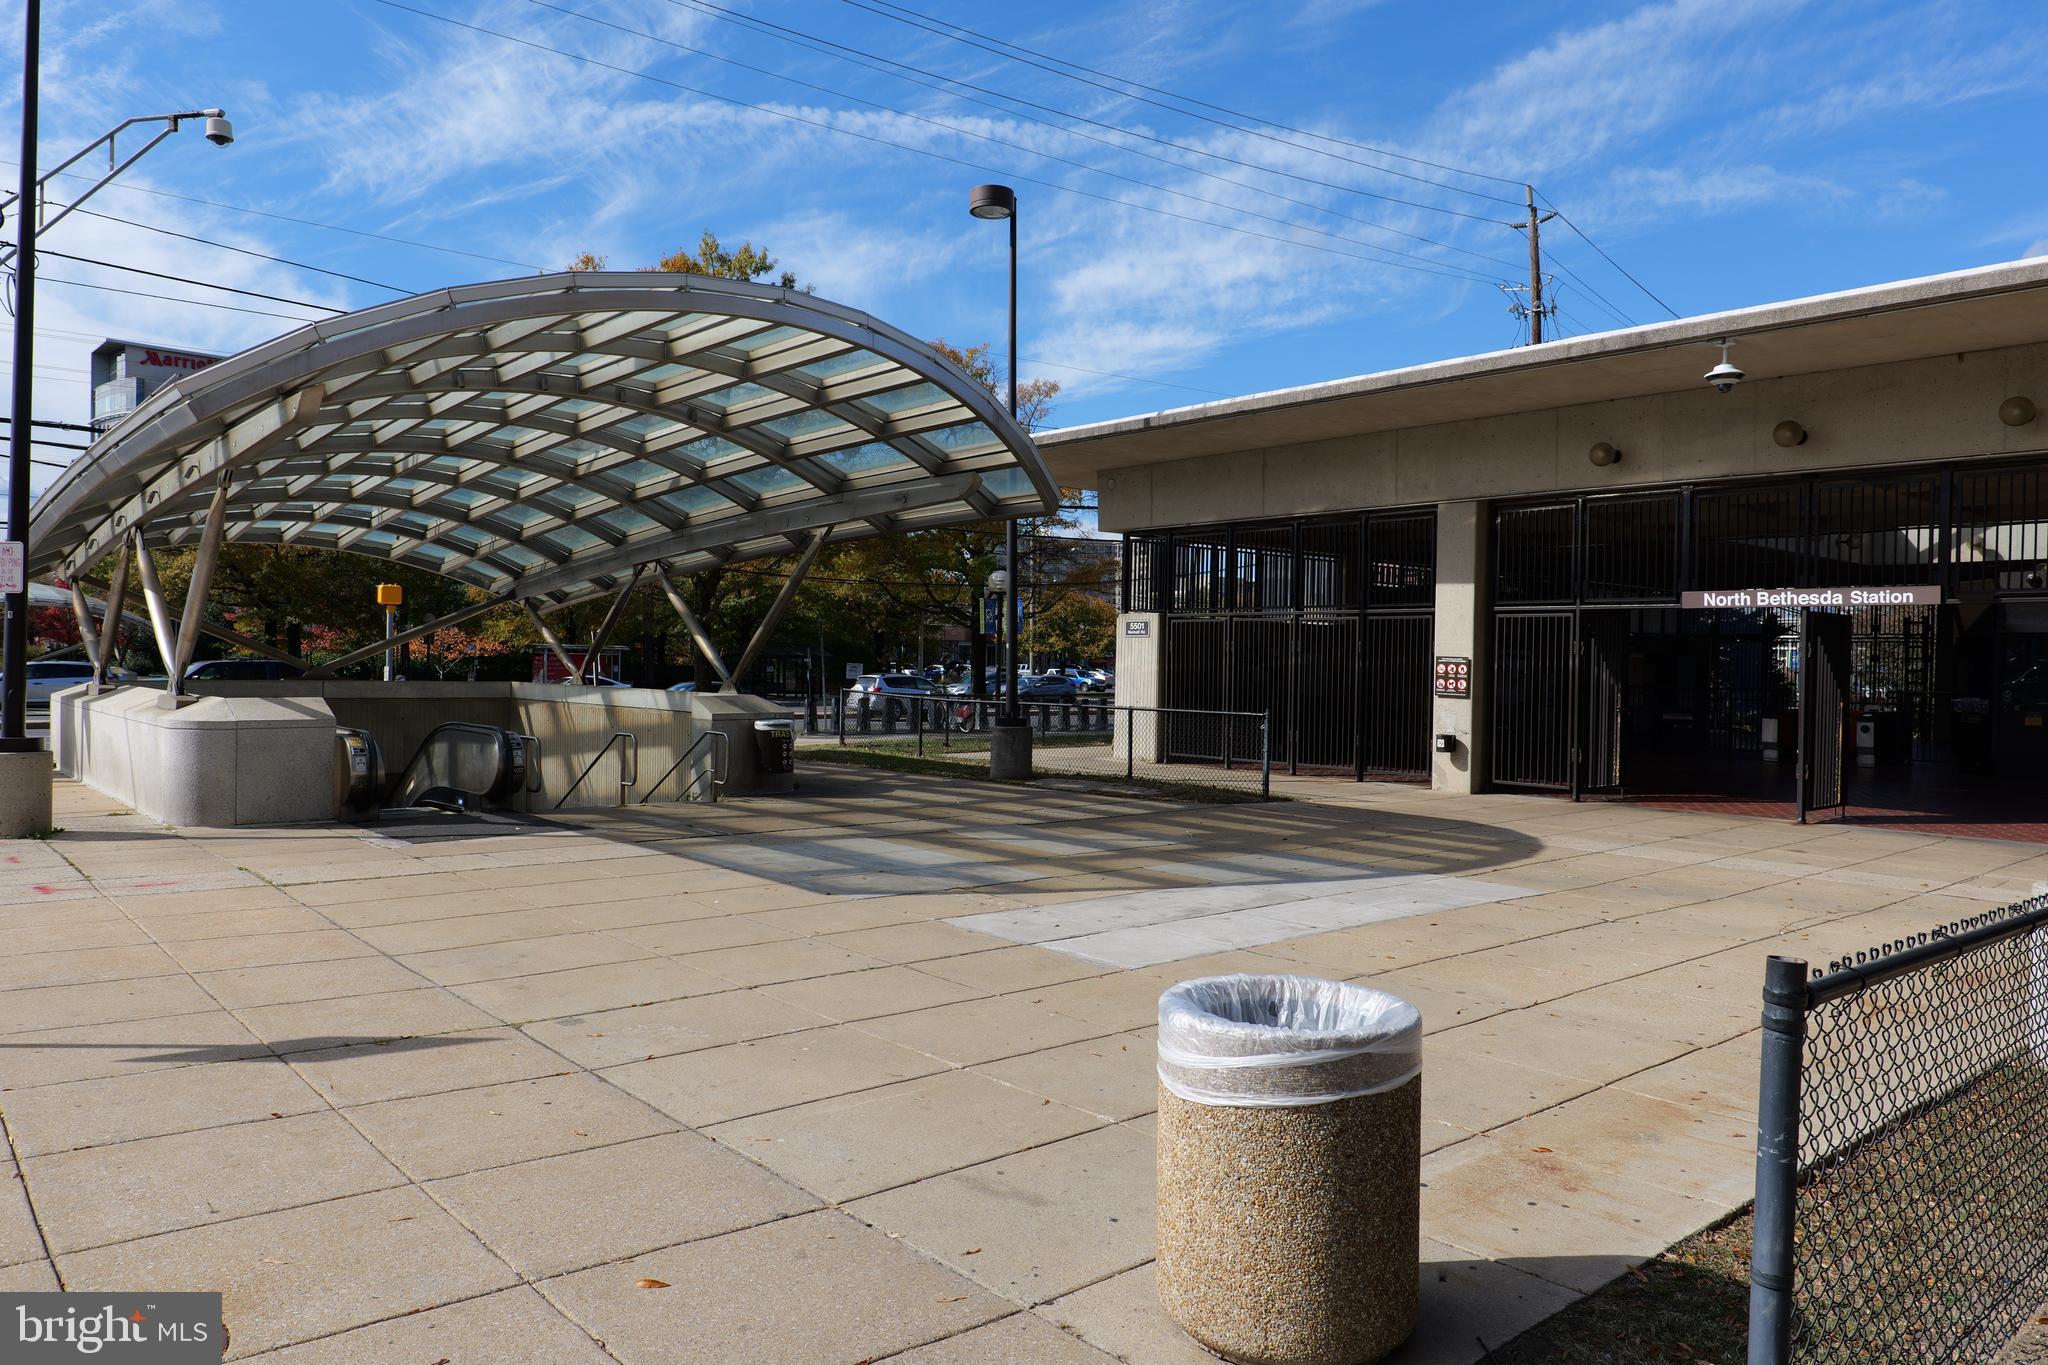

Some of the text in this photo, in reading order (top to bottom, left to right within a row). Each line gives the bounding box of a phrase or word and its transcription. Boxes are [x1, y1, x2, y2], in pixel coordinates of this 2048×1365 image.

[140, 350, 214, 369] Marrio
[1703, 590, 1914, 607] North Bethesda Station
[1130, 622, 1145, 630] 5501
